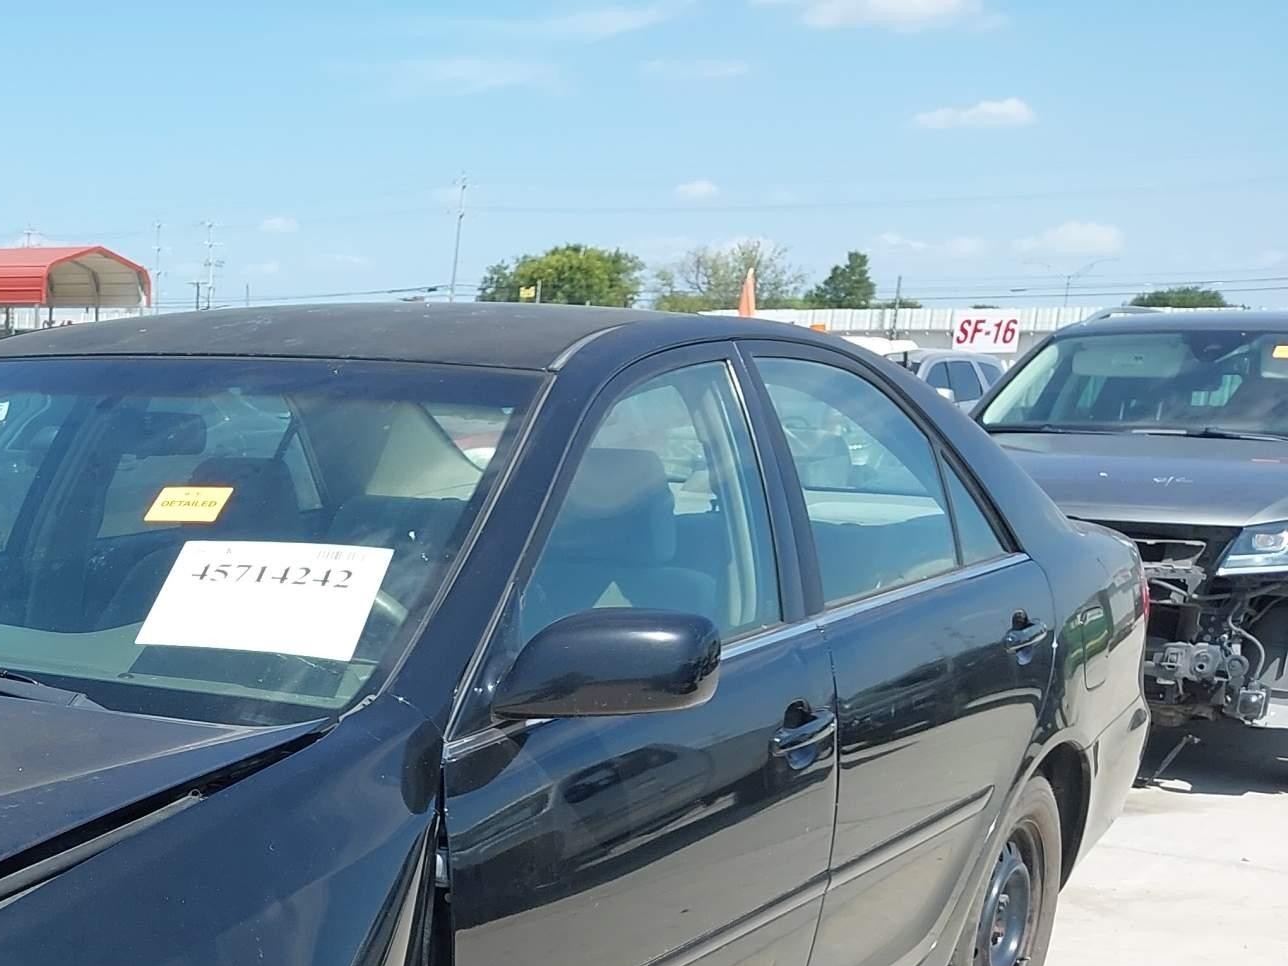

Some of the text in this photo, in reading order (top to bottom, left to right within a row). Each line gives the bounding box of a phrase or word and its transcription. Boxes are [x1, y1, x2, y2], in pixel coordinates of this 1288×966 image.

[956, 319, 1018, 344] SF-16
[160, 500, 218, 508] DETAILED
[191, 563, 354, 589] 45714242
